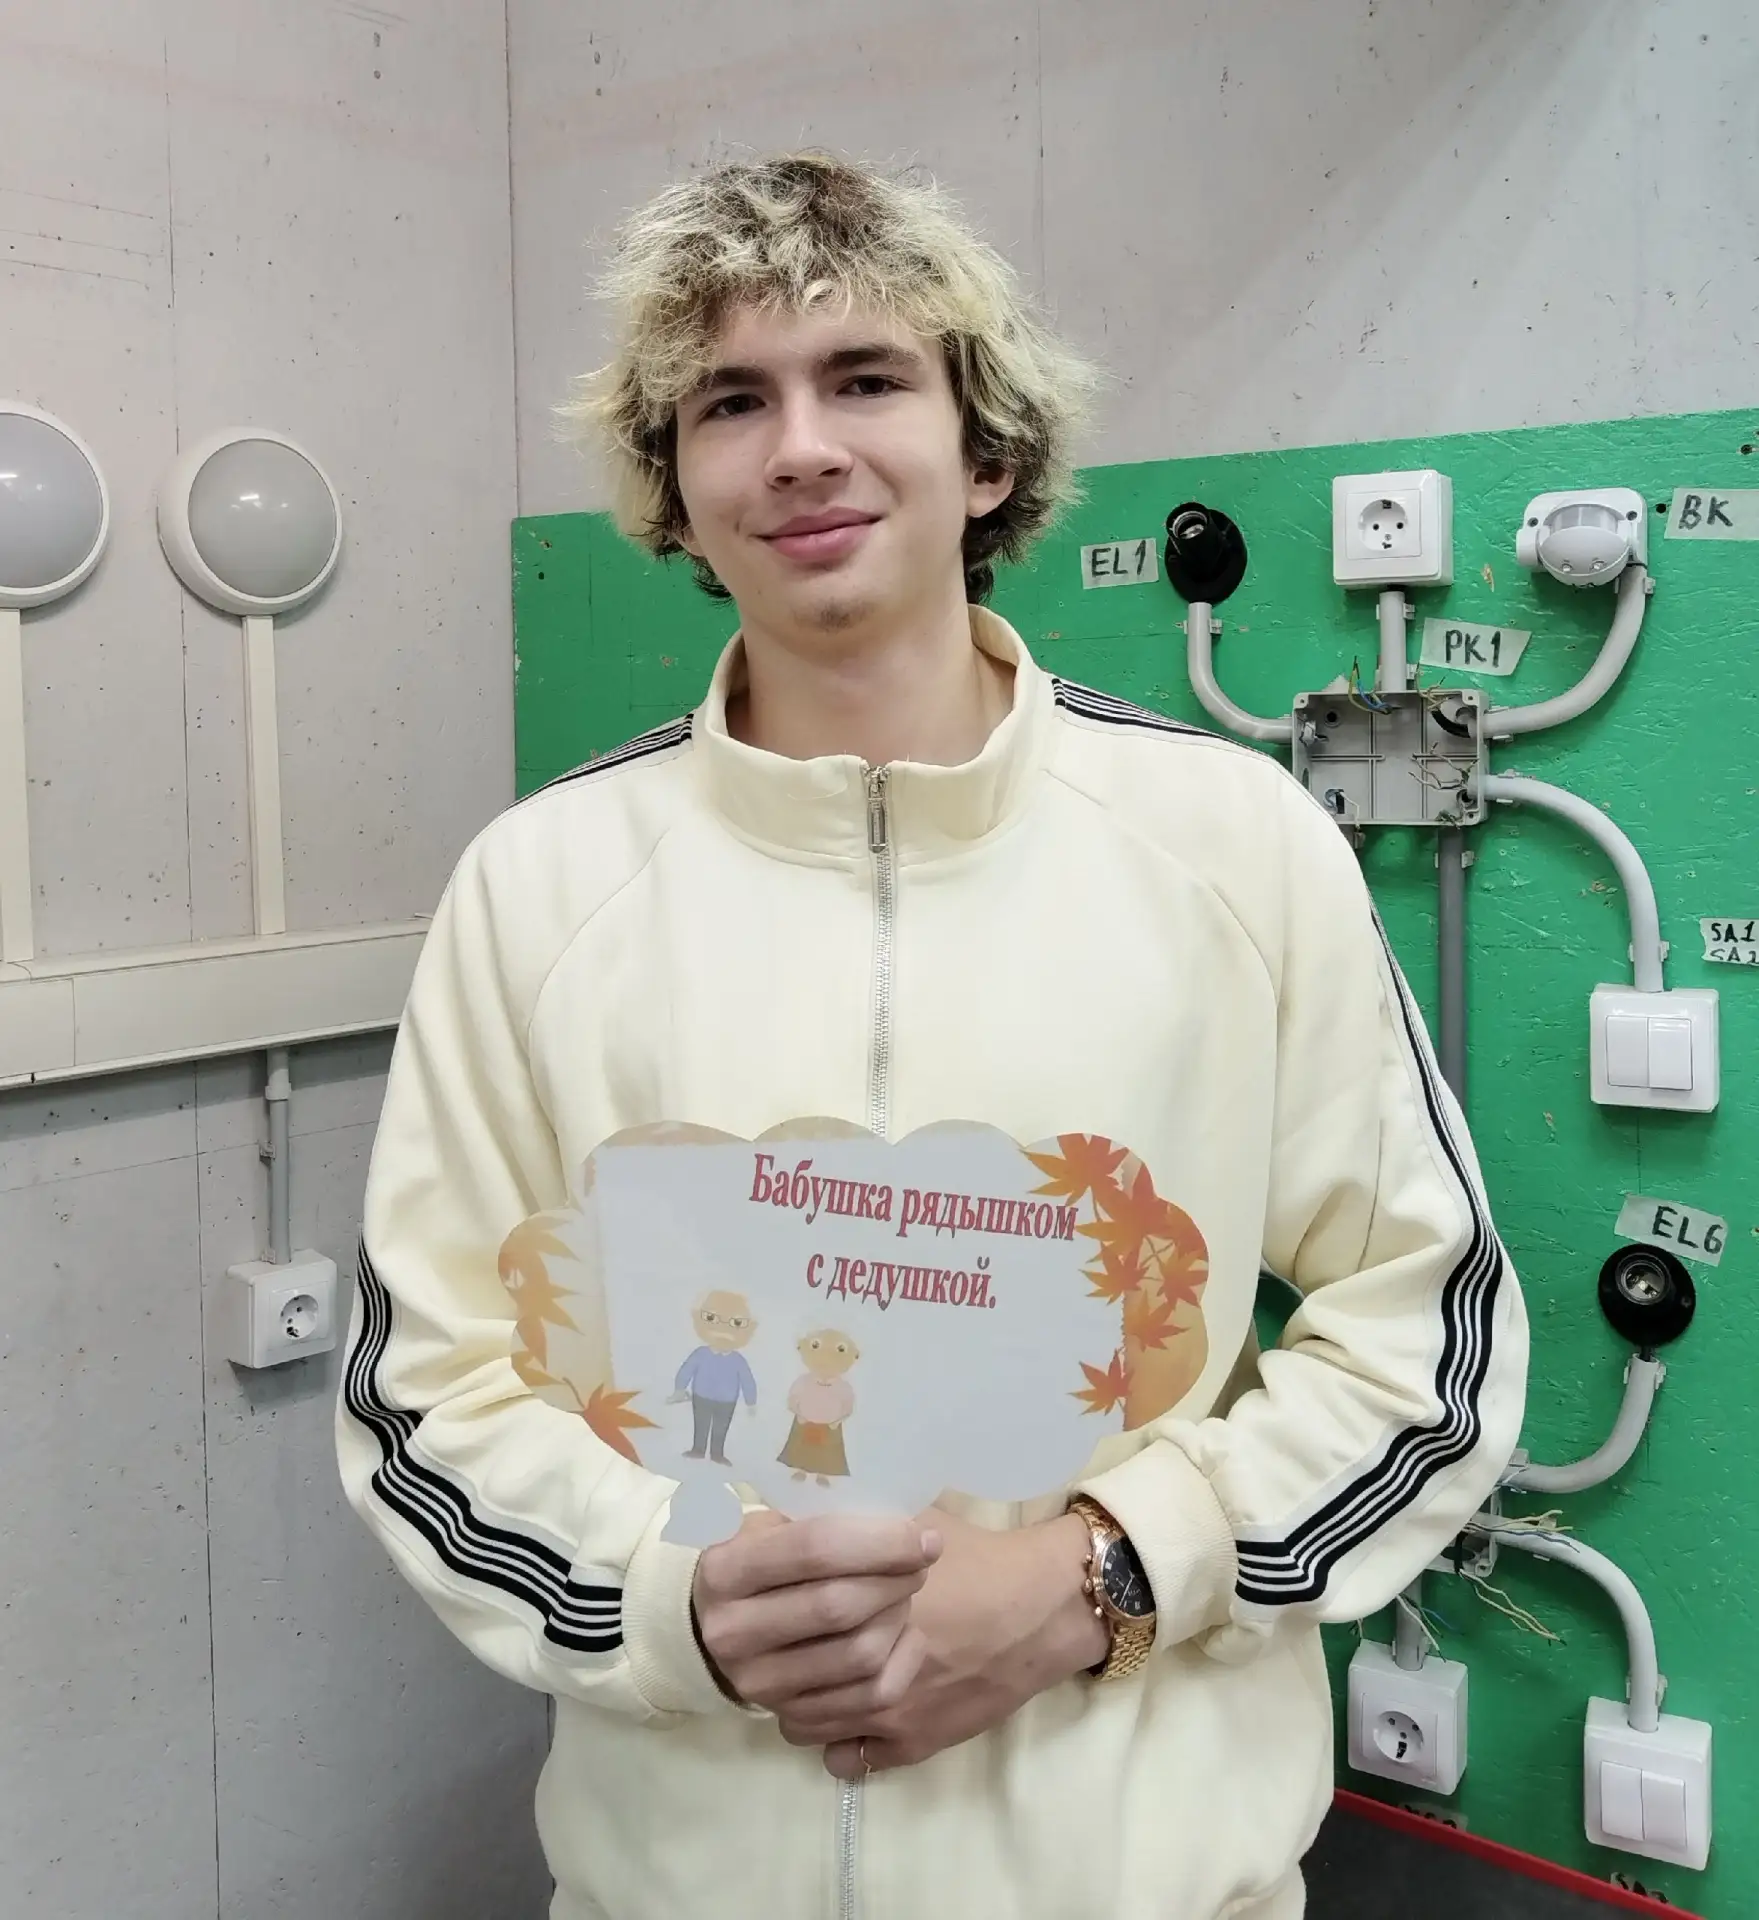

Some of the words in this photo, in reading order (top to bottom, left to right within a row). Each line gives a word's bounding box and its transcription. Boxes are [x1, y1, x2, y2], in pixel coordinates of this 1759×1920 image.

[1678, 494, 1733, 530] BK
[1091, 539, 1147, 578] EL1
[1445, 629, 1501, 668] PK1
[1711, 920, 1756, 943] SA1
[749, 1153, 893, 1225] Бабушка
[896, 1188, 1079, 1242] рядышком
[1652, 1205, 1724, 1255] EL6
[806, 1253, 825, 1289] с
[826, 1256, 997, 1312] дедушкой.
